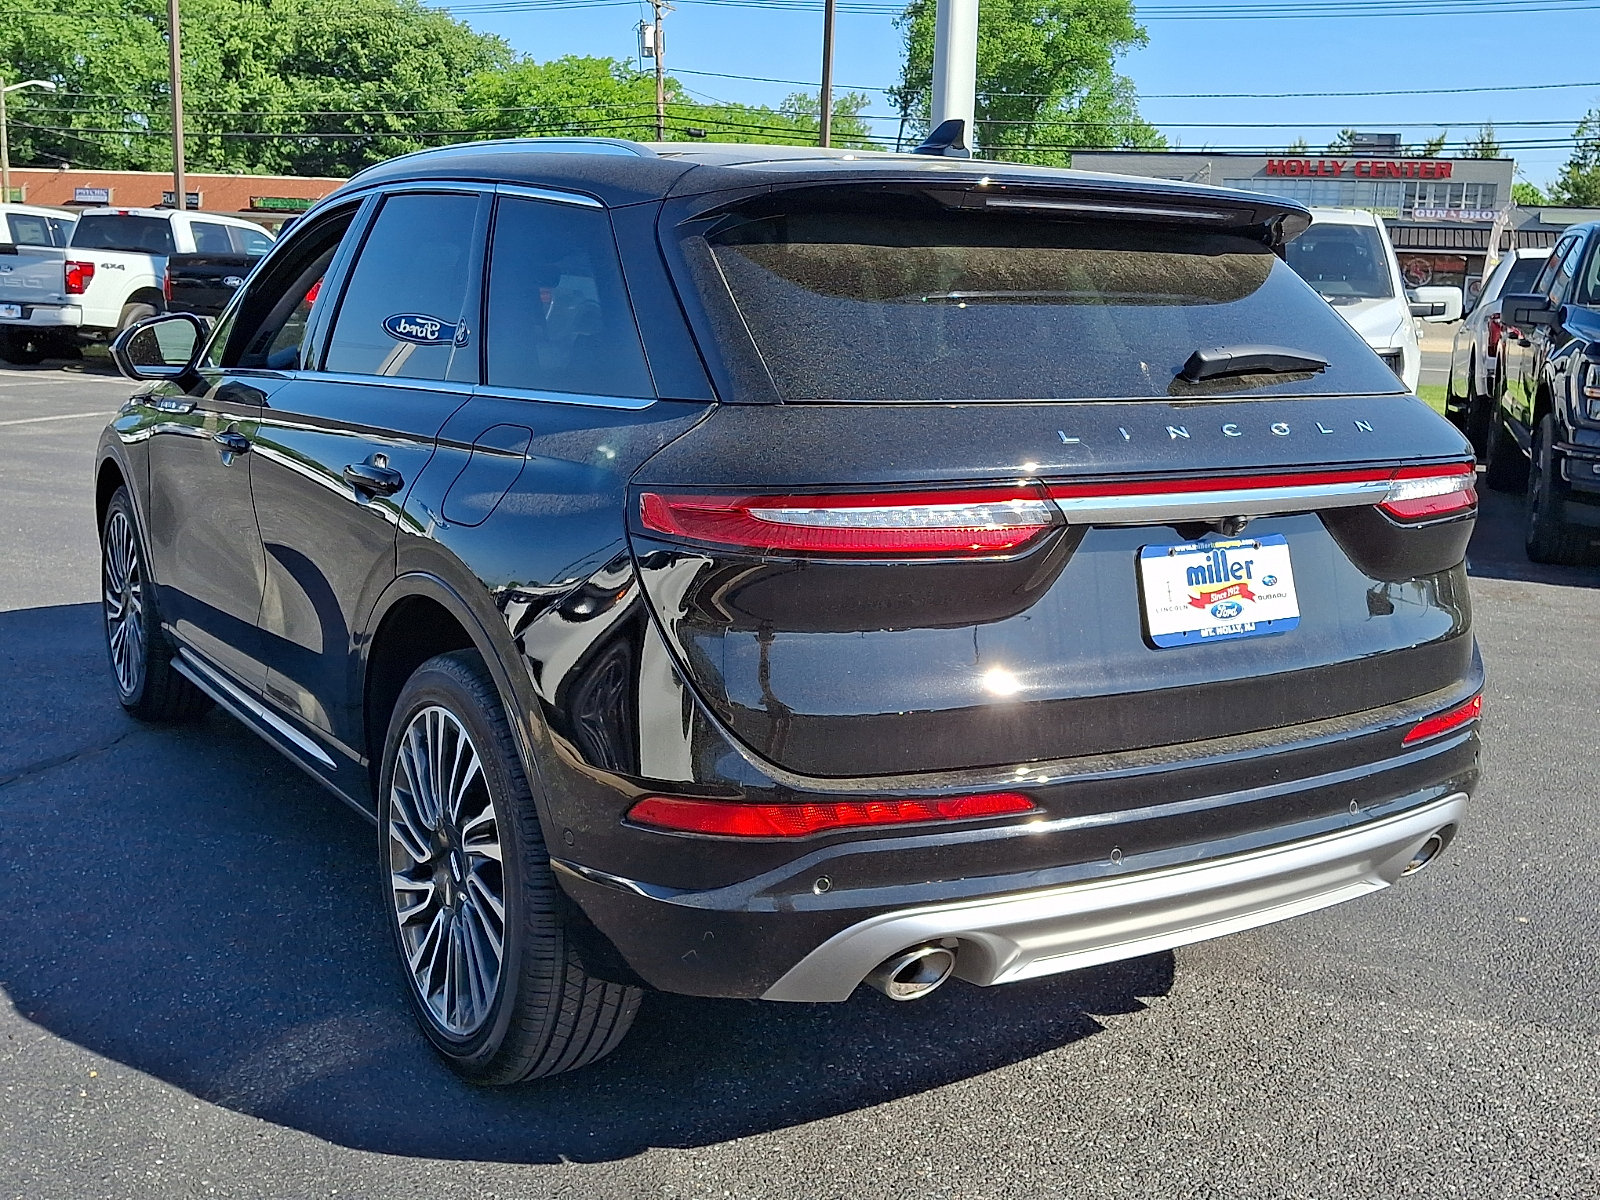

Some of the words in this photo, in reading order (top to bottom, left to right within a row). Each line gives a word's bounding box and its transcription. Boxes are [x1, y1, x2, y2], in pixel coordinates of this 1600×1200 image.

[1266, 160, 1347, 176] HOLLY
[1354, 161, 1452, 178] CENTER
[1415, 209, 1446, 218] GUN
[1058, 420, 1374, 443] LINCOLN
[1186, 550, 1254, 586] miller
[1210, 592, 1227, 603] Since
